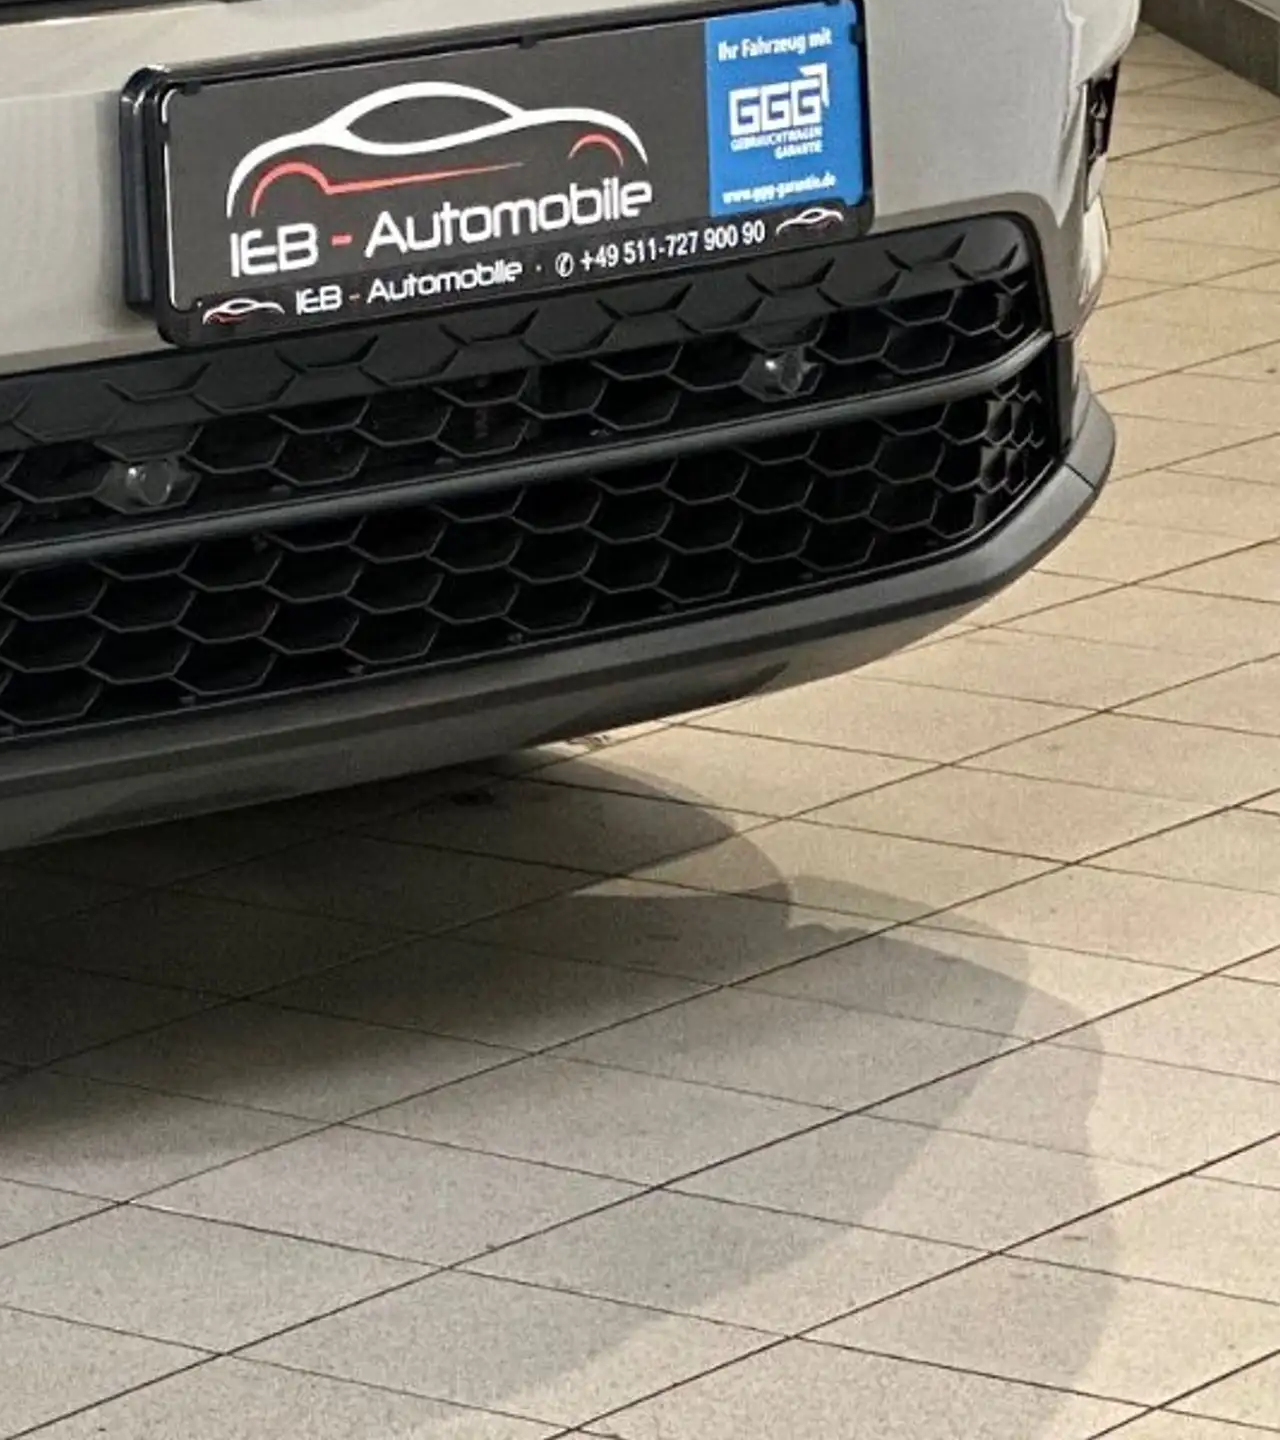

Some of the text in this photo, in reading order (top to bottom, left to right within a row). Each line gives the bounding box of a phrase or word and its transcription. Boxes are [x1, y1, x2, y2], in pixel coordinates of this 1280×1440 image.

[718, 27, 832, 61] Ihr Fahrzeug mit
[729, 75, 824, 136] GGG
[230, 223, 319, 278] IEB
[364, 176, 652, 258] Automobile
[296, 285, 342, 315] IEB
[366, 259, 523, 304] Automobile
[580, 244, 619, 271] +49
[624, 231, 698, 264] 511-727
[704, 225, 738, 251] 900
[742, 220, 766, 244] 90
